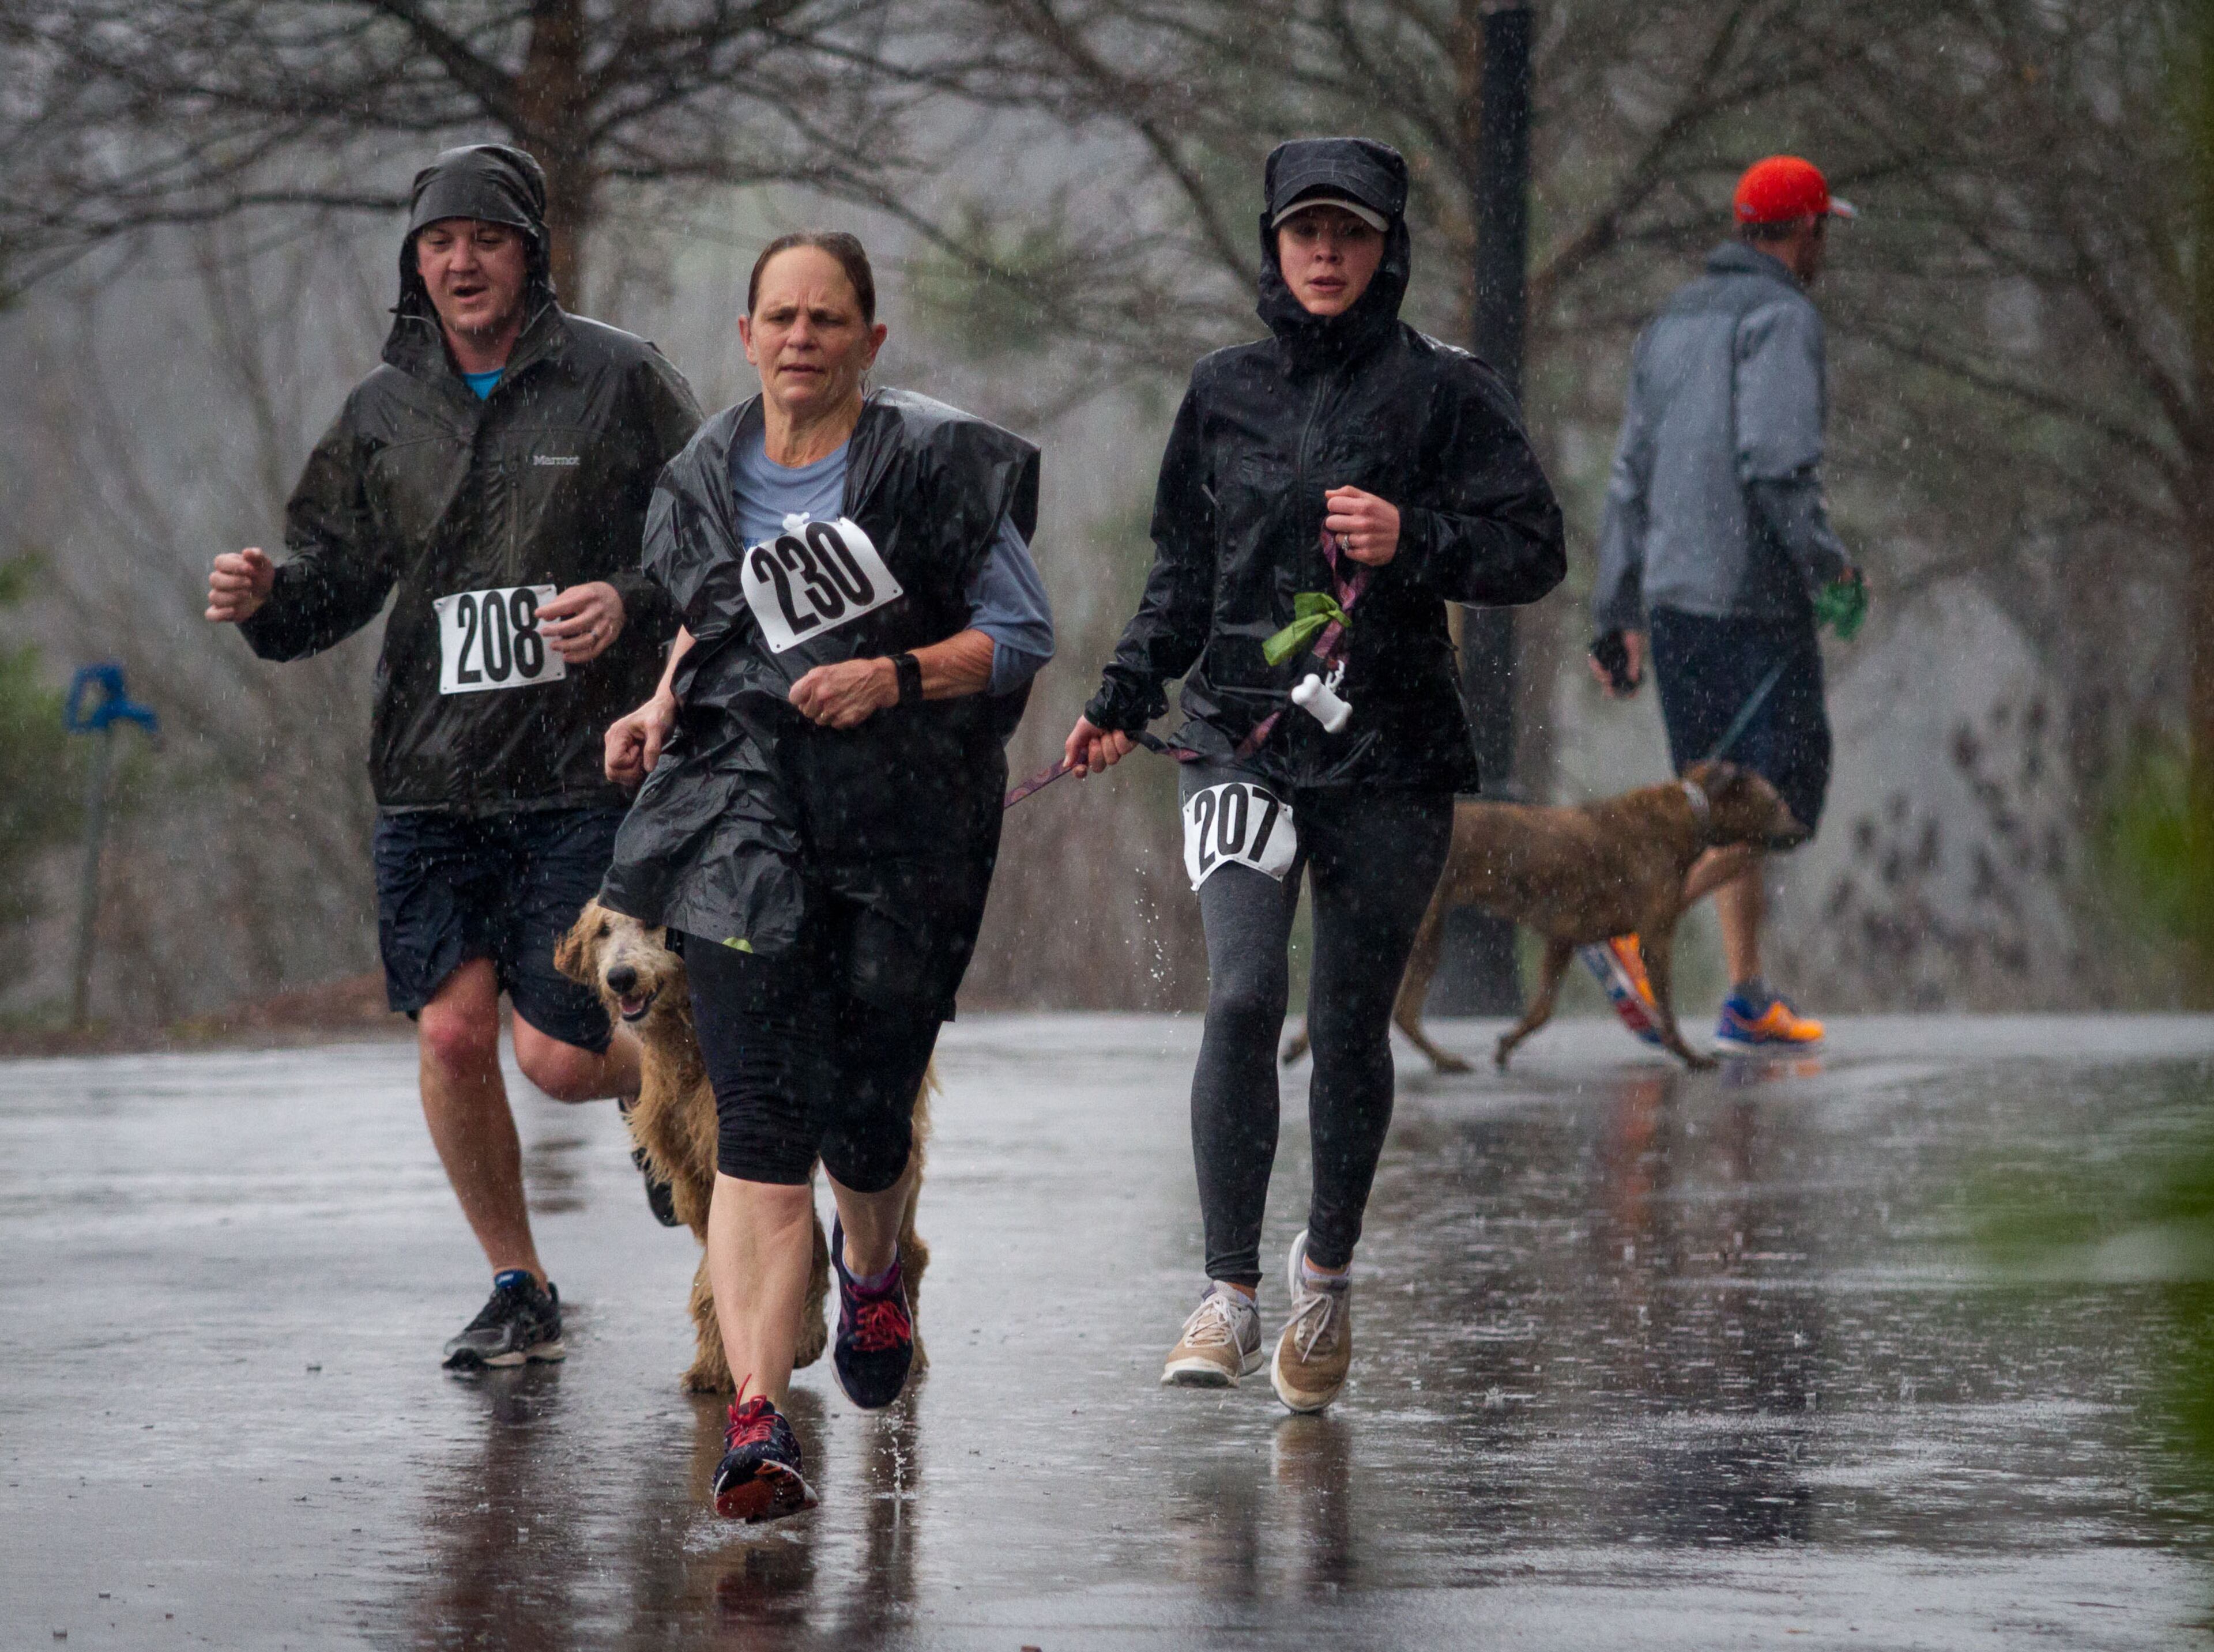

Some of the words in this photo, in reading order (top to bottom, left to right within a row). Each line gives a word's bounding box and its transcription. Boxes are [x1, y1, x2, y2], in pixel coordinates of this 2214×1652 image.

[751, 522, 875, 636] 230
[458, 588, 544, 684] 208
[1194, 783, 1279, 876] 207
